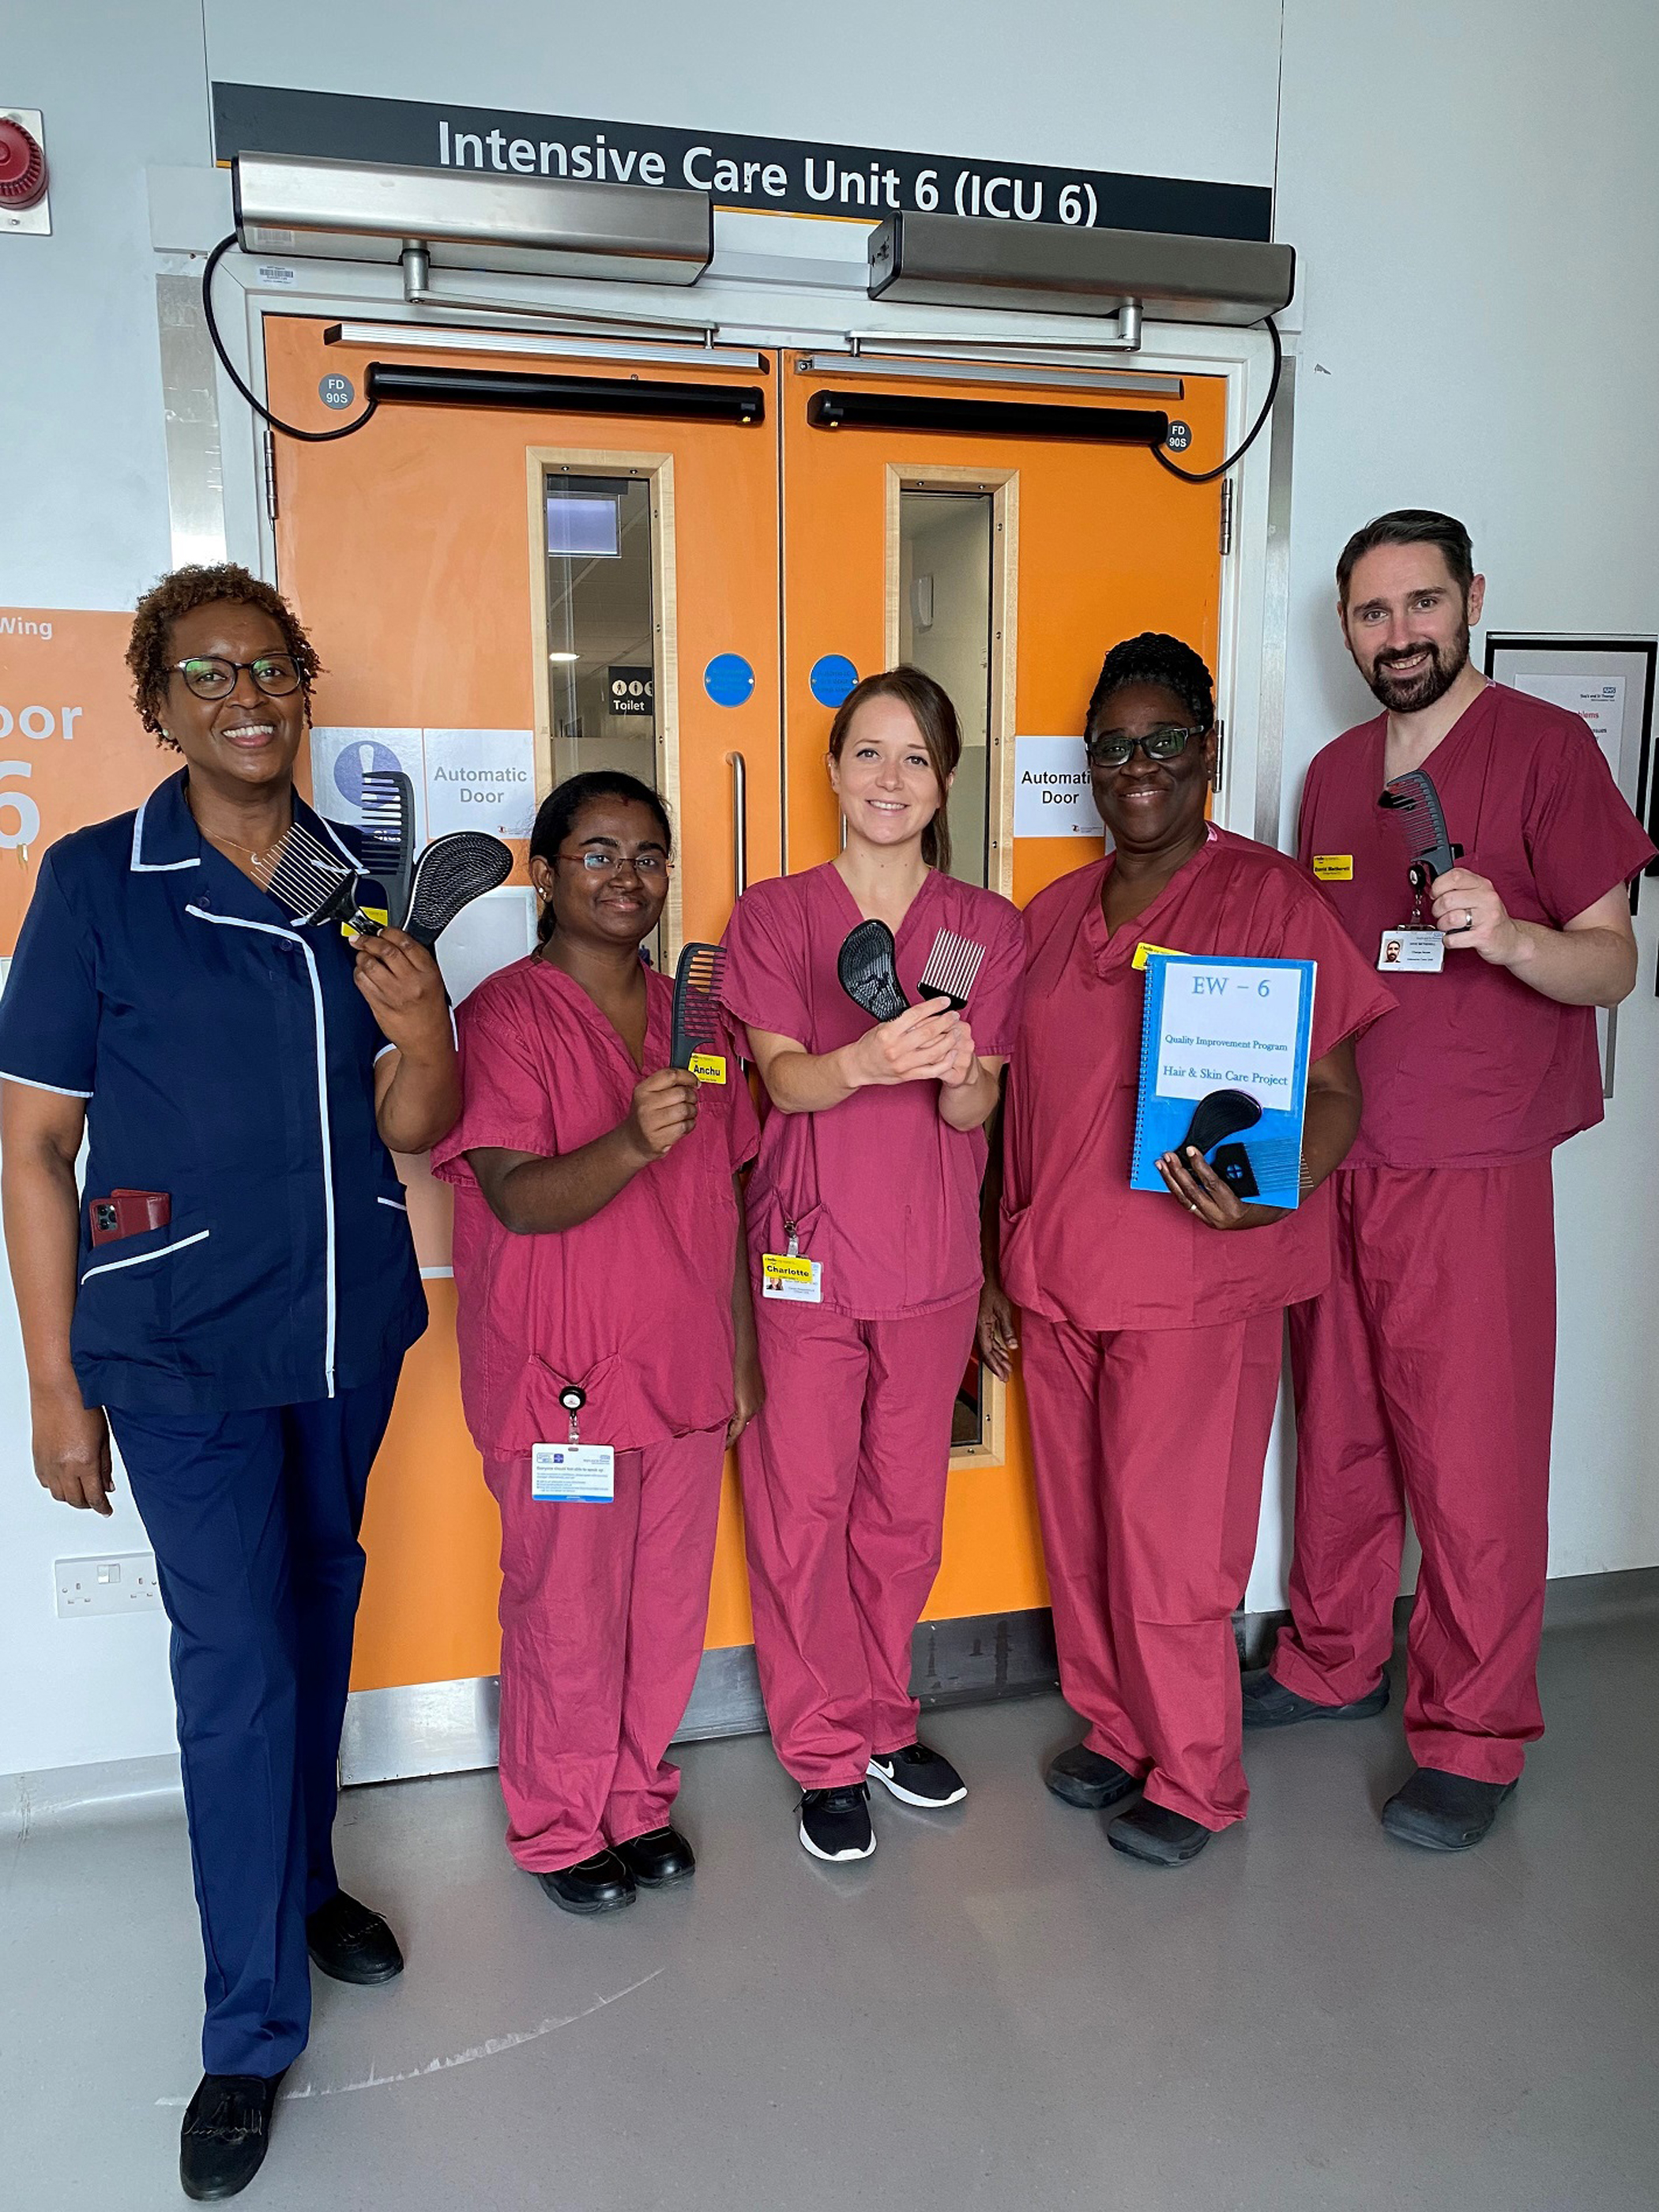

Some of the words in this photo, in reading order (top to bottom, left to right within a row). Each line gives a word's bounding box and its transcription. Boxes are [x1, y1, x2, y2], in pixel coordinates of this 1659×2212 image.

[438, 120, 666, 186] Intensive
[683, 146, 788, 198] Care
[804, 157, 901, 209] Unit
[914, 169, 939, 212] 6
[954, 170, 1043, 221] (ICU
[1058, 182, 1098, 228] 6)
[328, 379, 345, 389] FD
[325, 392, 348, 404] 90S
[1172, 425, 1186, 435] FD
[1169, 437, 1187, 448] 90S
[613, 699, 645, 712] Toilet
[434, 766, 528, 782] Automatic
[1021, 770, 1091, 784] Automati
[460, 788, 505, 803] Door
[1042, 790, 1080, 804] Door
[1192, 976, 1229, 995] EW
[1258, 980, 1270, 997] 6
[1164, 1034, 1194, 1046] Quality
[1195, 1036, 1251, 1048] Improvement
[1252, 1040, 1288, 1051] Program
[694, 1063, 720, 1077] Anchu
[1163, 1065, 1187, 1078] Hair
[1188, 1066, 1198, 1078] &
[1200, 1068, 1223, 1080] Skin
[1225, 1070, 1249, 1082] Care
[1251, 1072, 1288, 1086] Project
[766, 1265, 810, 1277] Charlotte
